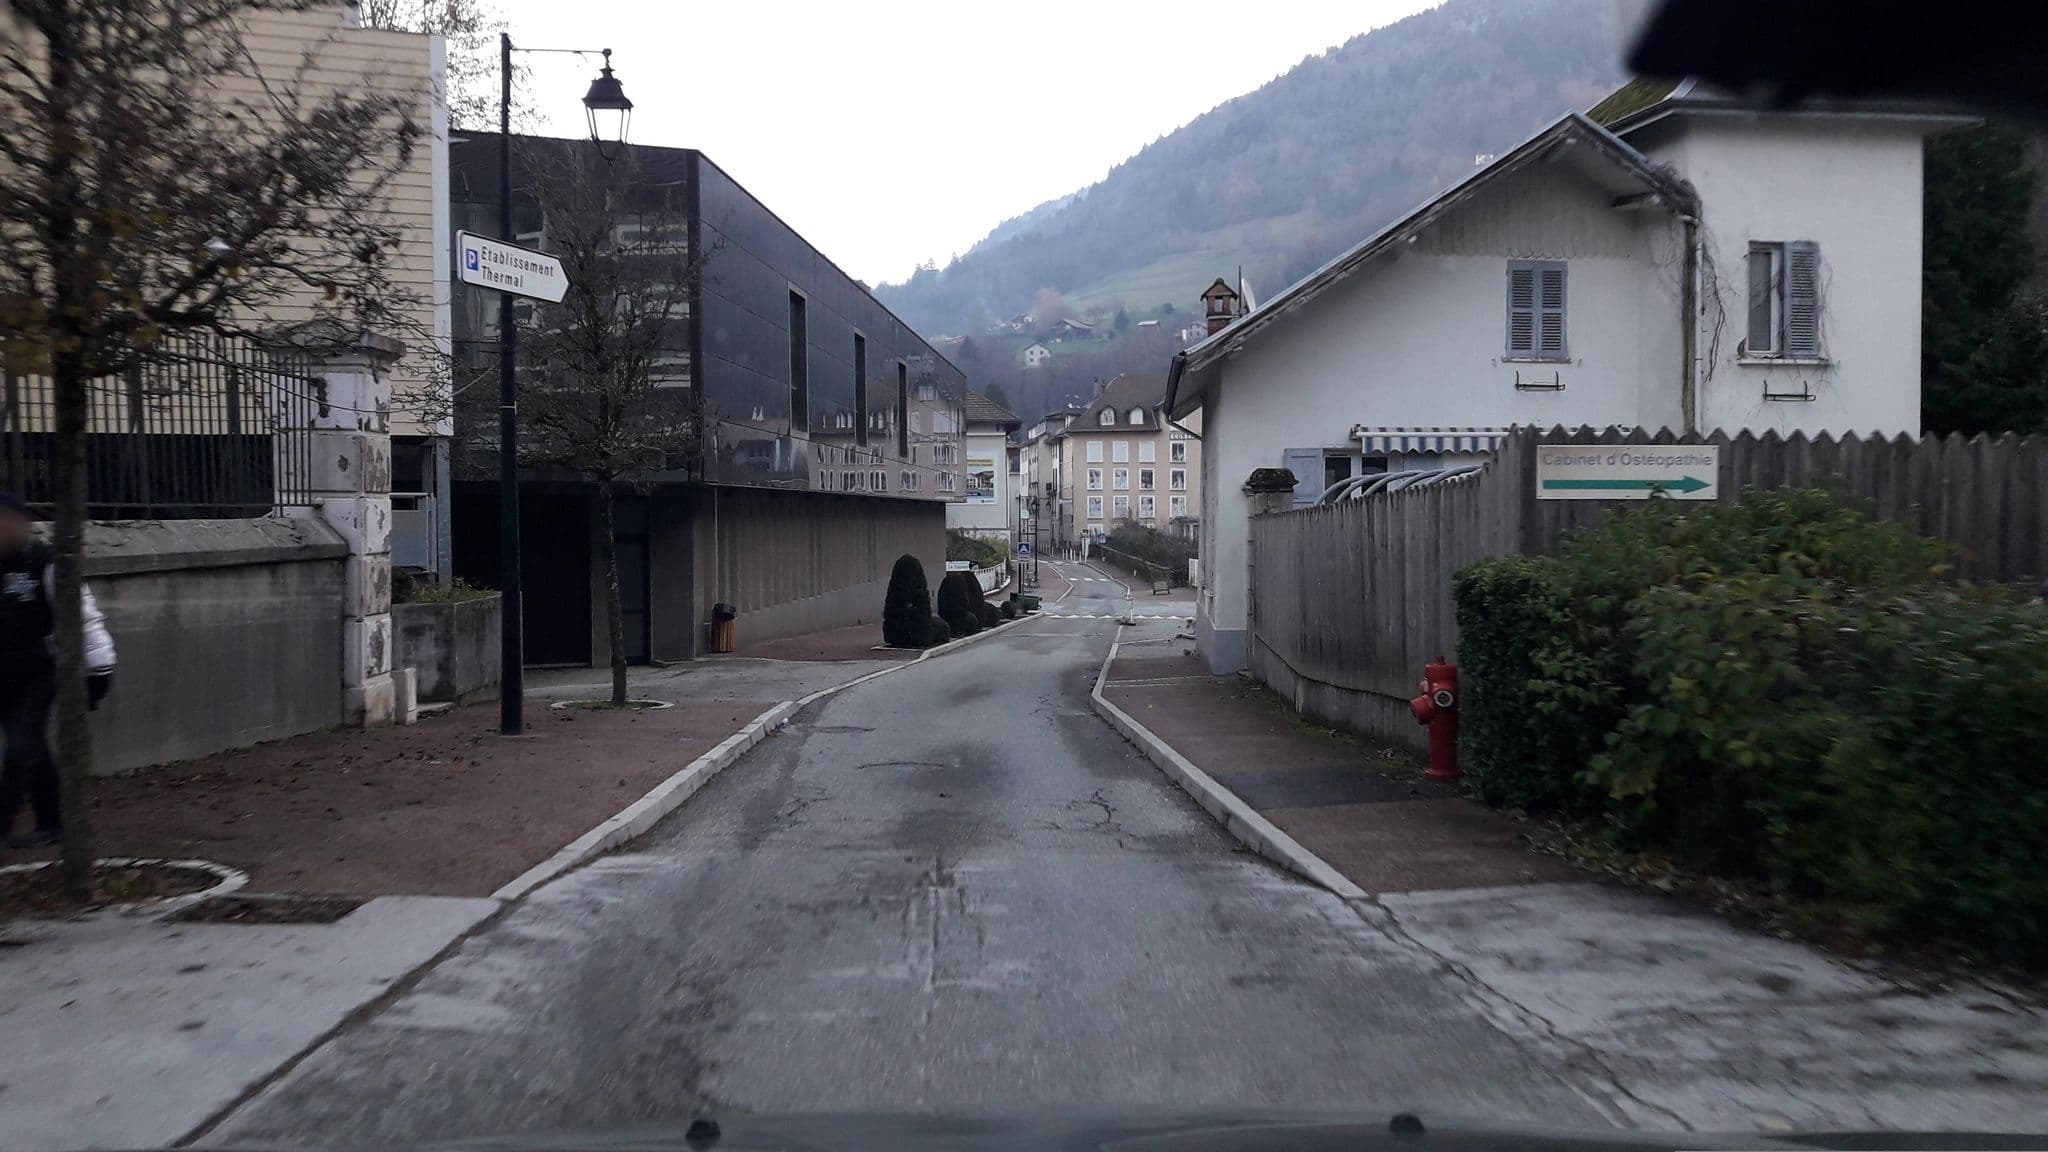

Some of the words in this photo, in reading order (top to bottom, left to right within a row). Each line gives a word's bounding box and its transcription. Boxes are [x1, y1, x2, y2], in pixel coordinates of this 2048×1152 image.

[481, 246, 554, 277] Etablissement
[481, 265, 524, 288] Thermal
[1543, 453, 1601, 466] Cabinet
[1606, 452, 1713, 468] d'Ostéopathie
